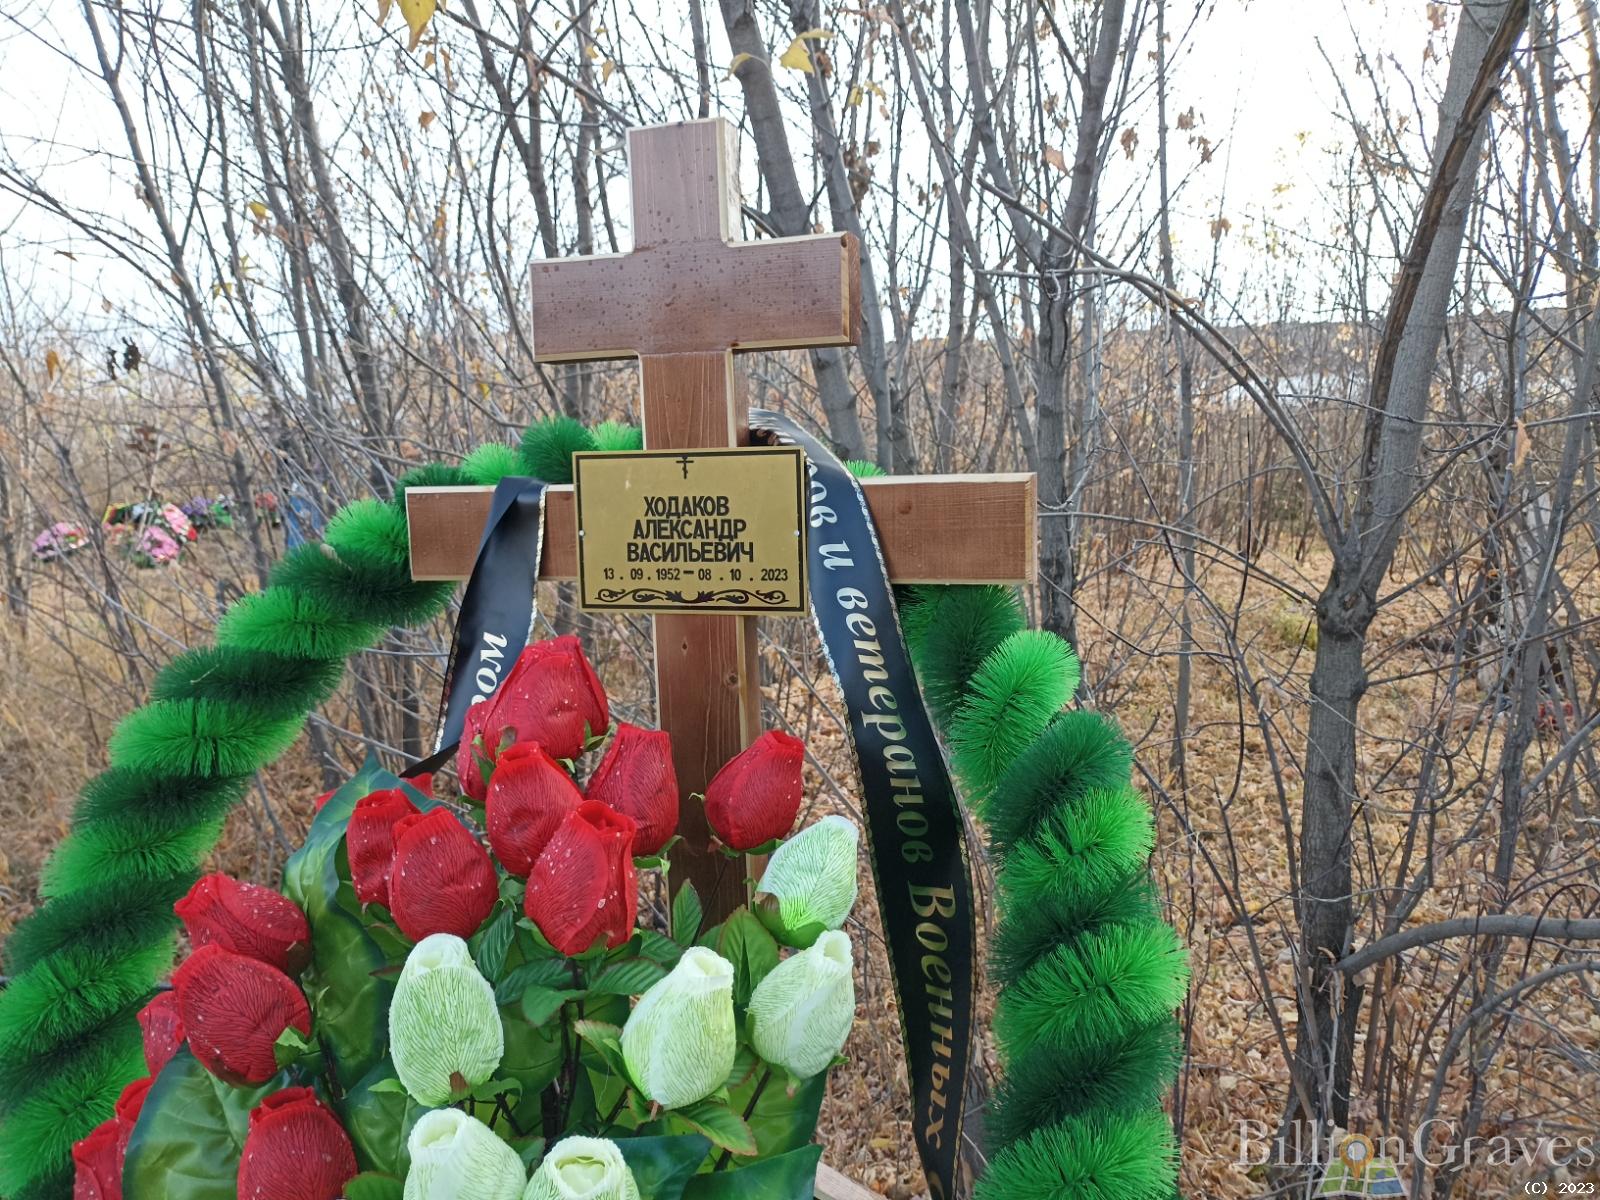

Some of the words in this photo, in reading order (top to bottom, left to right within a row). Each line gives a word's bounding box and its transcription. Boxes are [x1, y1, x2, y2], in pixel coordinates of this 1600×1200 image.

[643, 495, 730, 519] ХОДАКОВ
[632, 518, 747, 542] АЛЕКСАНДР
[626, 541, 754, 563] ВАСИЛЬЕВИЧ
[818, 540, 855, 571] и
[836, 586, 934, 864] ветеранов
[908, 881, 956, 1150] Военных
